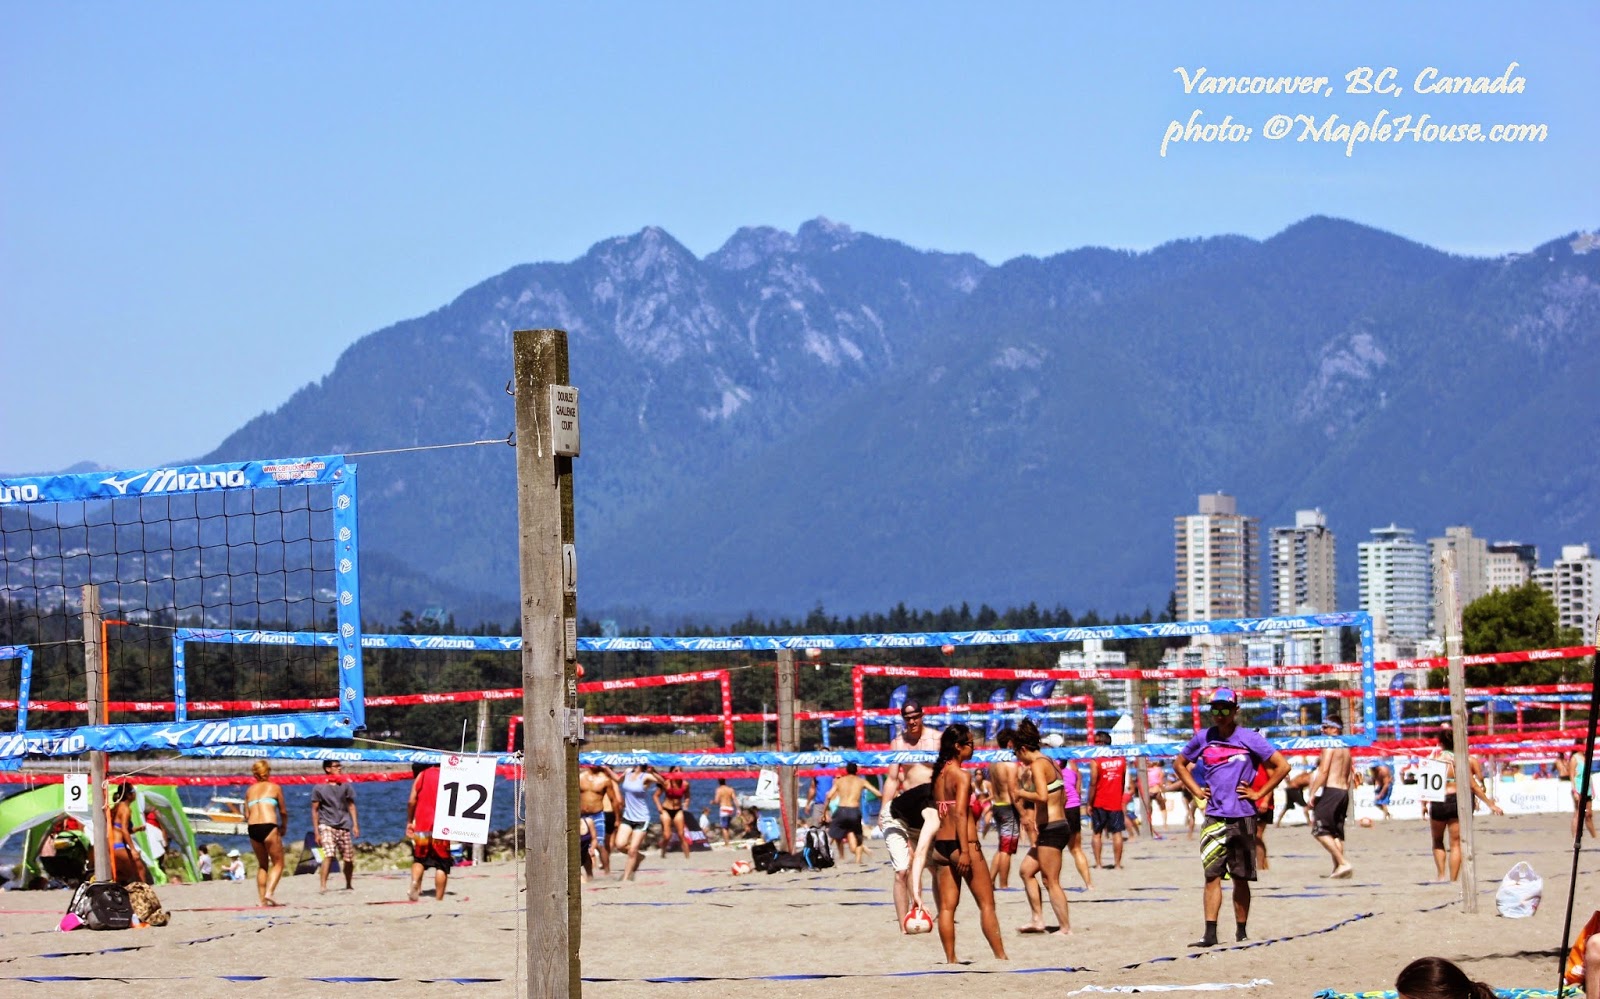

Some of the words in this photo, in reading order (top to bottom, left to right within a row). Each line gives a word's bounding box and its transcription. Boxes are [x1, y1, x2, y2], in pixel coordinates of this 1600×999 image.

[557, 391, 574, 403] DOUBLES
[556, 405, 576, 418] CHALLENGE
[561, 421, 573, 431] COURT
[1101, 760, 1122, 769] STAFF
[1420, 773, 1443, 791] 10
[70, 785, 81, 801] 9
[443, 781, 488, 820] 12
